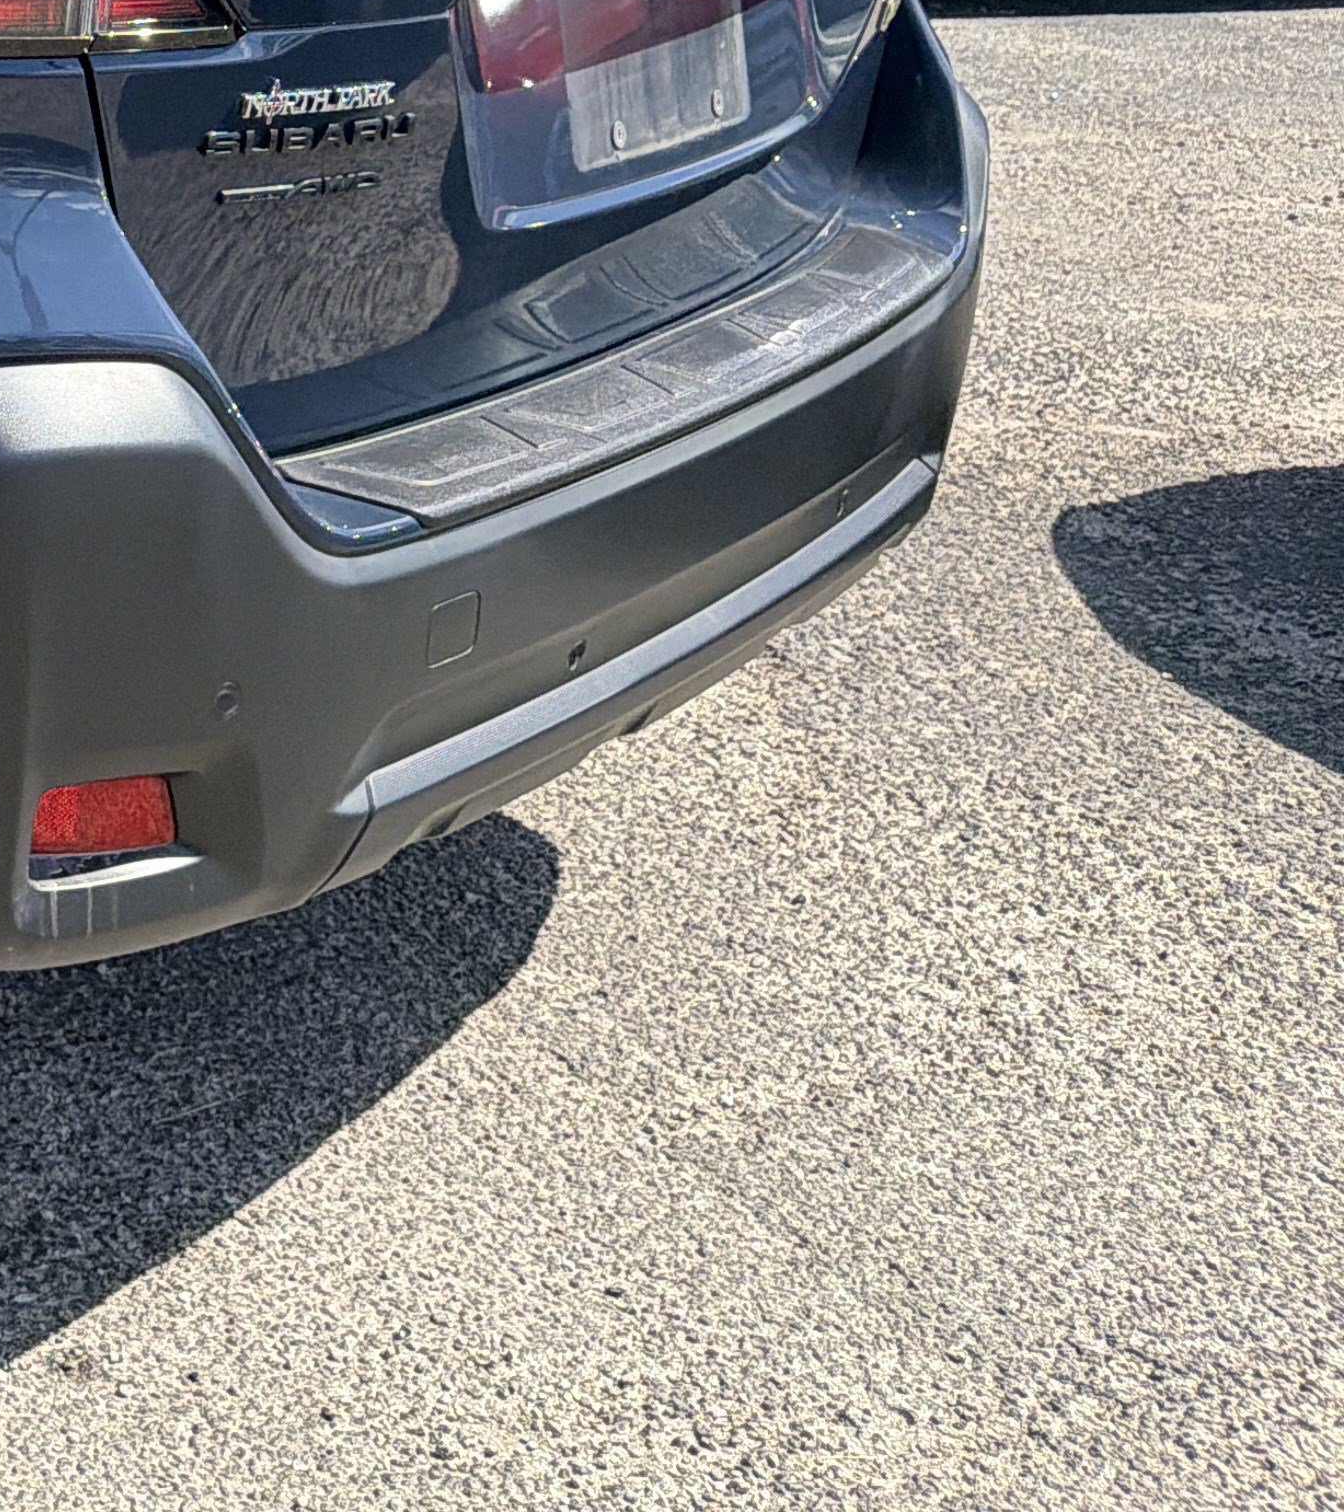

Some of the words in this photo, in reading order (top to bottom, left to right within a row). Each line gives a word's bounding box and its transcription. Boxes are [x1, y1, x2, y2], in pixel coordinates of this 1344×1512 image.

[241, 82, 332, 123] NORTH
[335, 81, 396, 109] PARK
[205, 112, 416, 155] SUBARU
